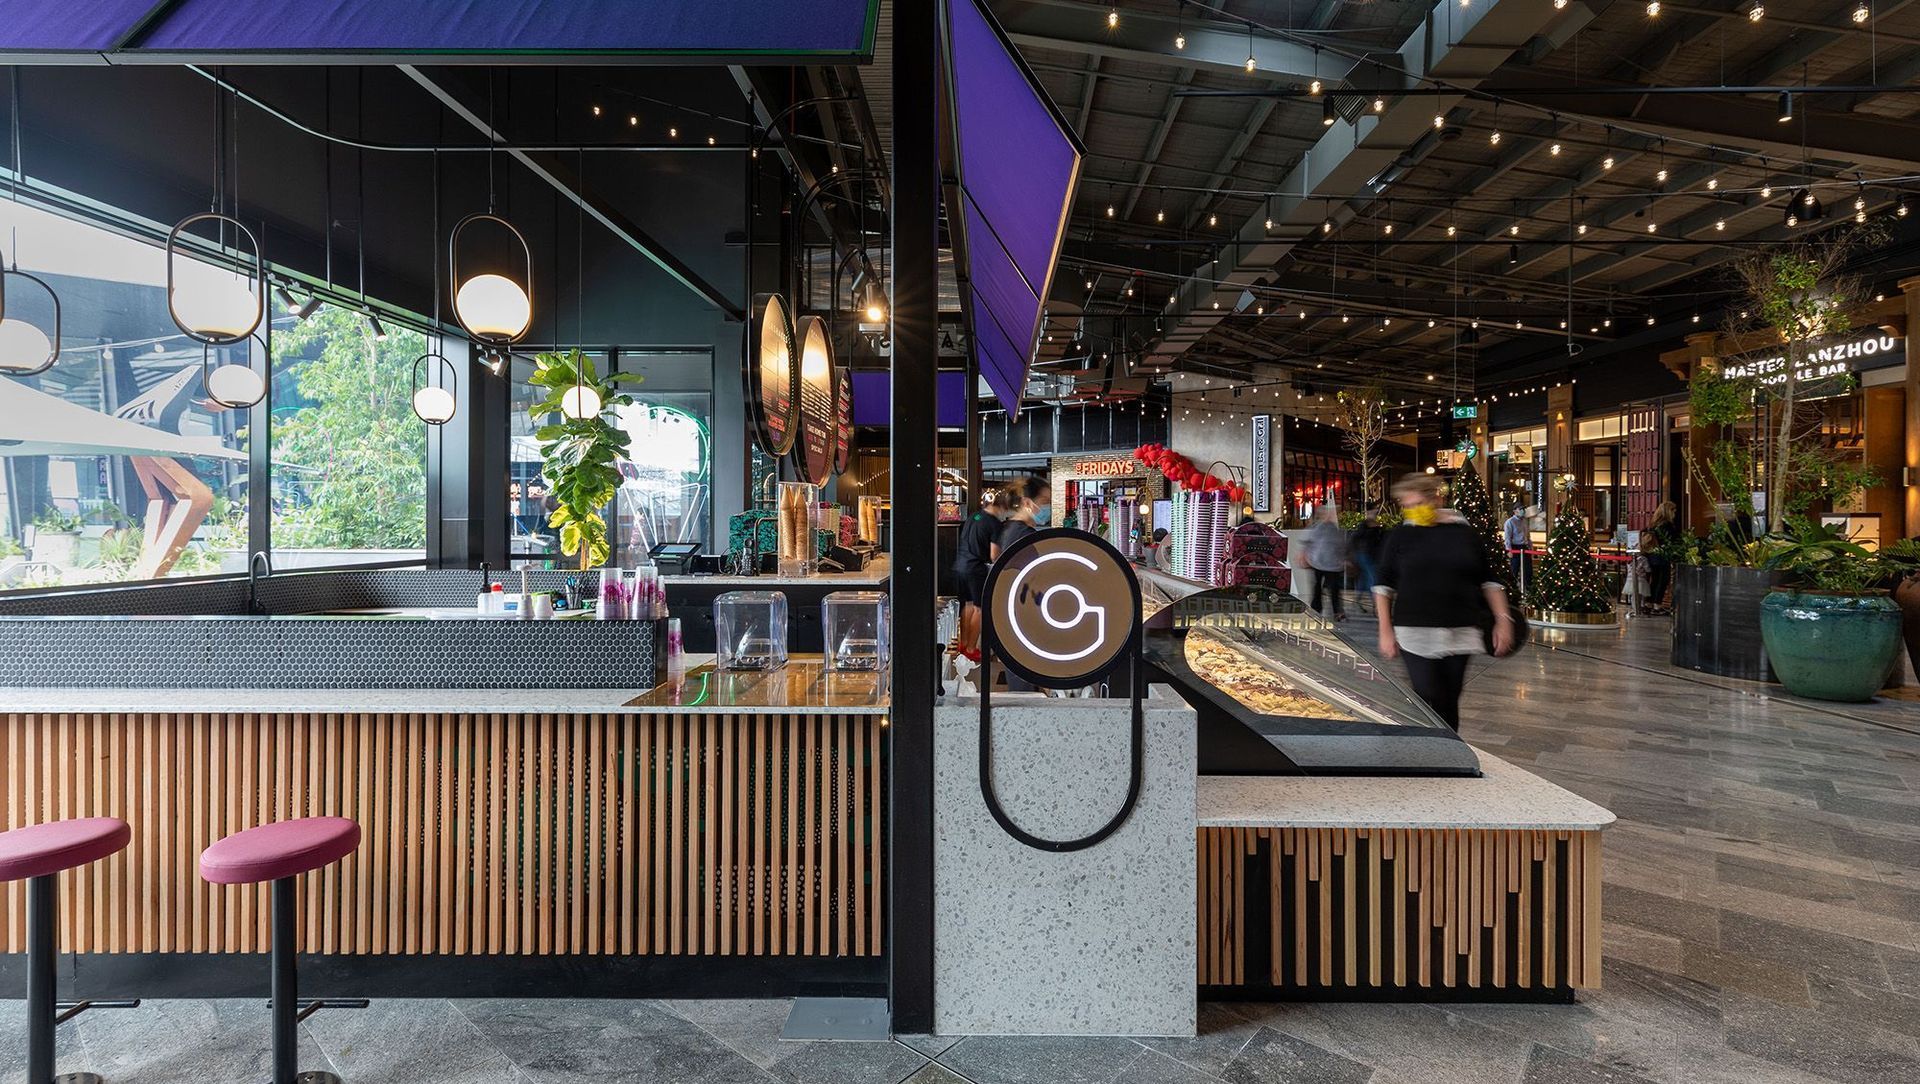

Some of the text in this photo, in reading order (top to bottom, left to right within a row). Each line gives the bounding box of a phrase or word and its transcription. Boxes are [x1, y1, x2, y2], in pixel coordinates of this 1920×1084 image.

[1760, 362, 1847, 385] OOLE BAR
[1257, 417, 1265, 437] Grill
[1257, 447, 1265, 462] Bar
[1082, 460, 1135, 476] FRIDAYS
[1257, 464, 1265, 508] American
